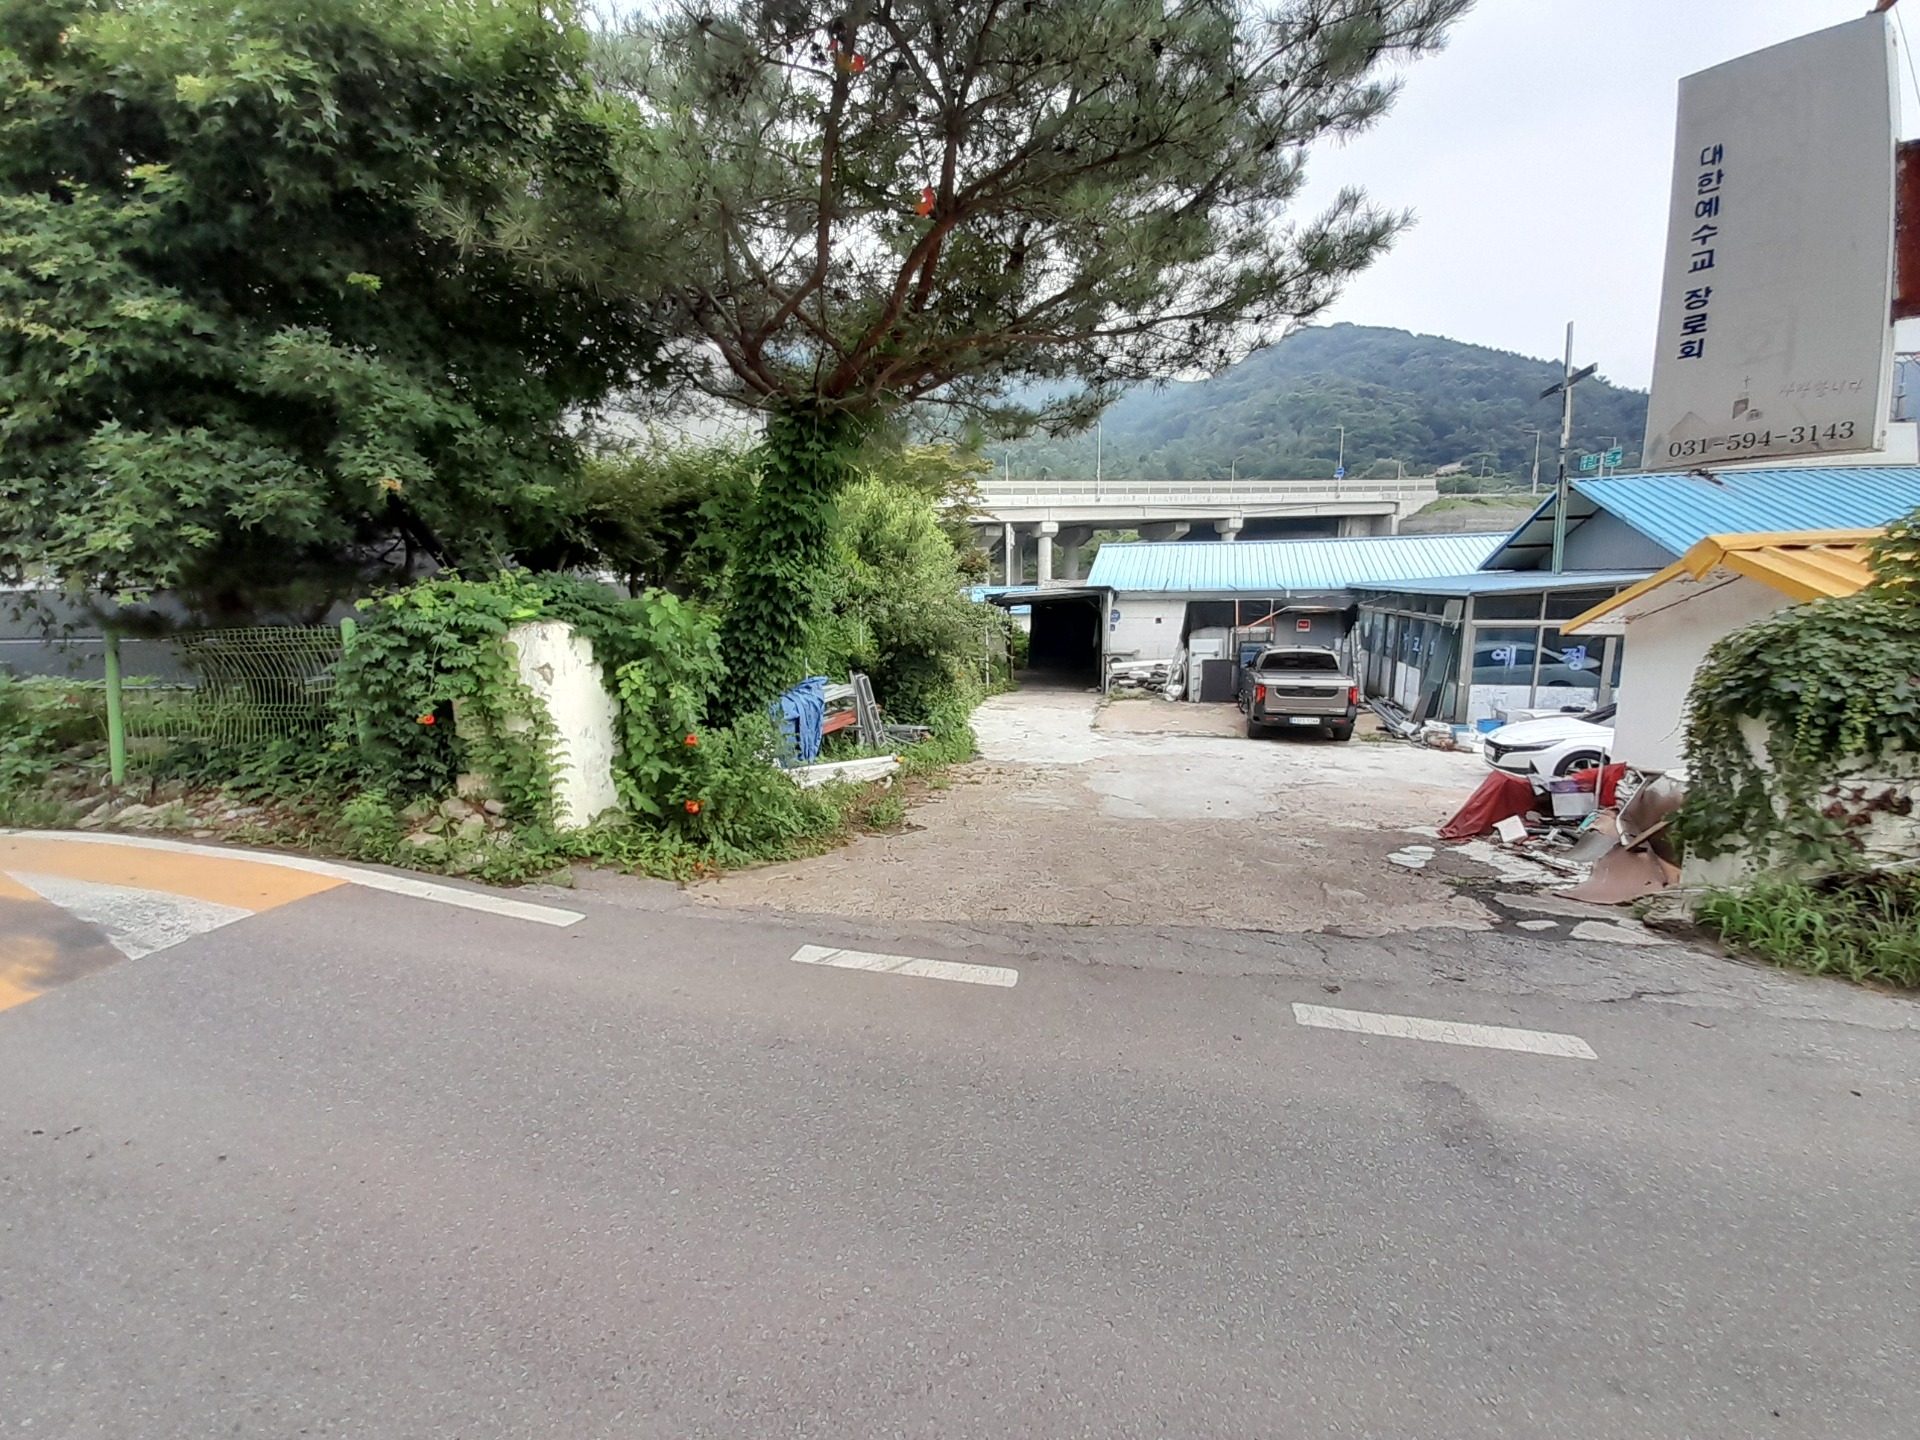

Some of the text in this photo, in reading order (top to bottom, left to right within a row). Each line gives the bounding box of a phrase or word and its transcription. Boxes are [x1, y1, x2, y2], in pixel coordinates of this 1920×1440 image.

[1677, 143, 1724, 360] 대한예수교 장로회
[1668, 420, 1856, 458] 031-594-3143
